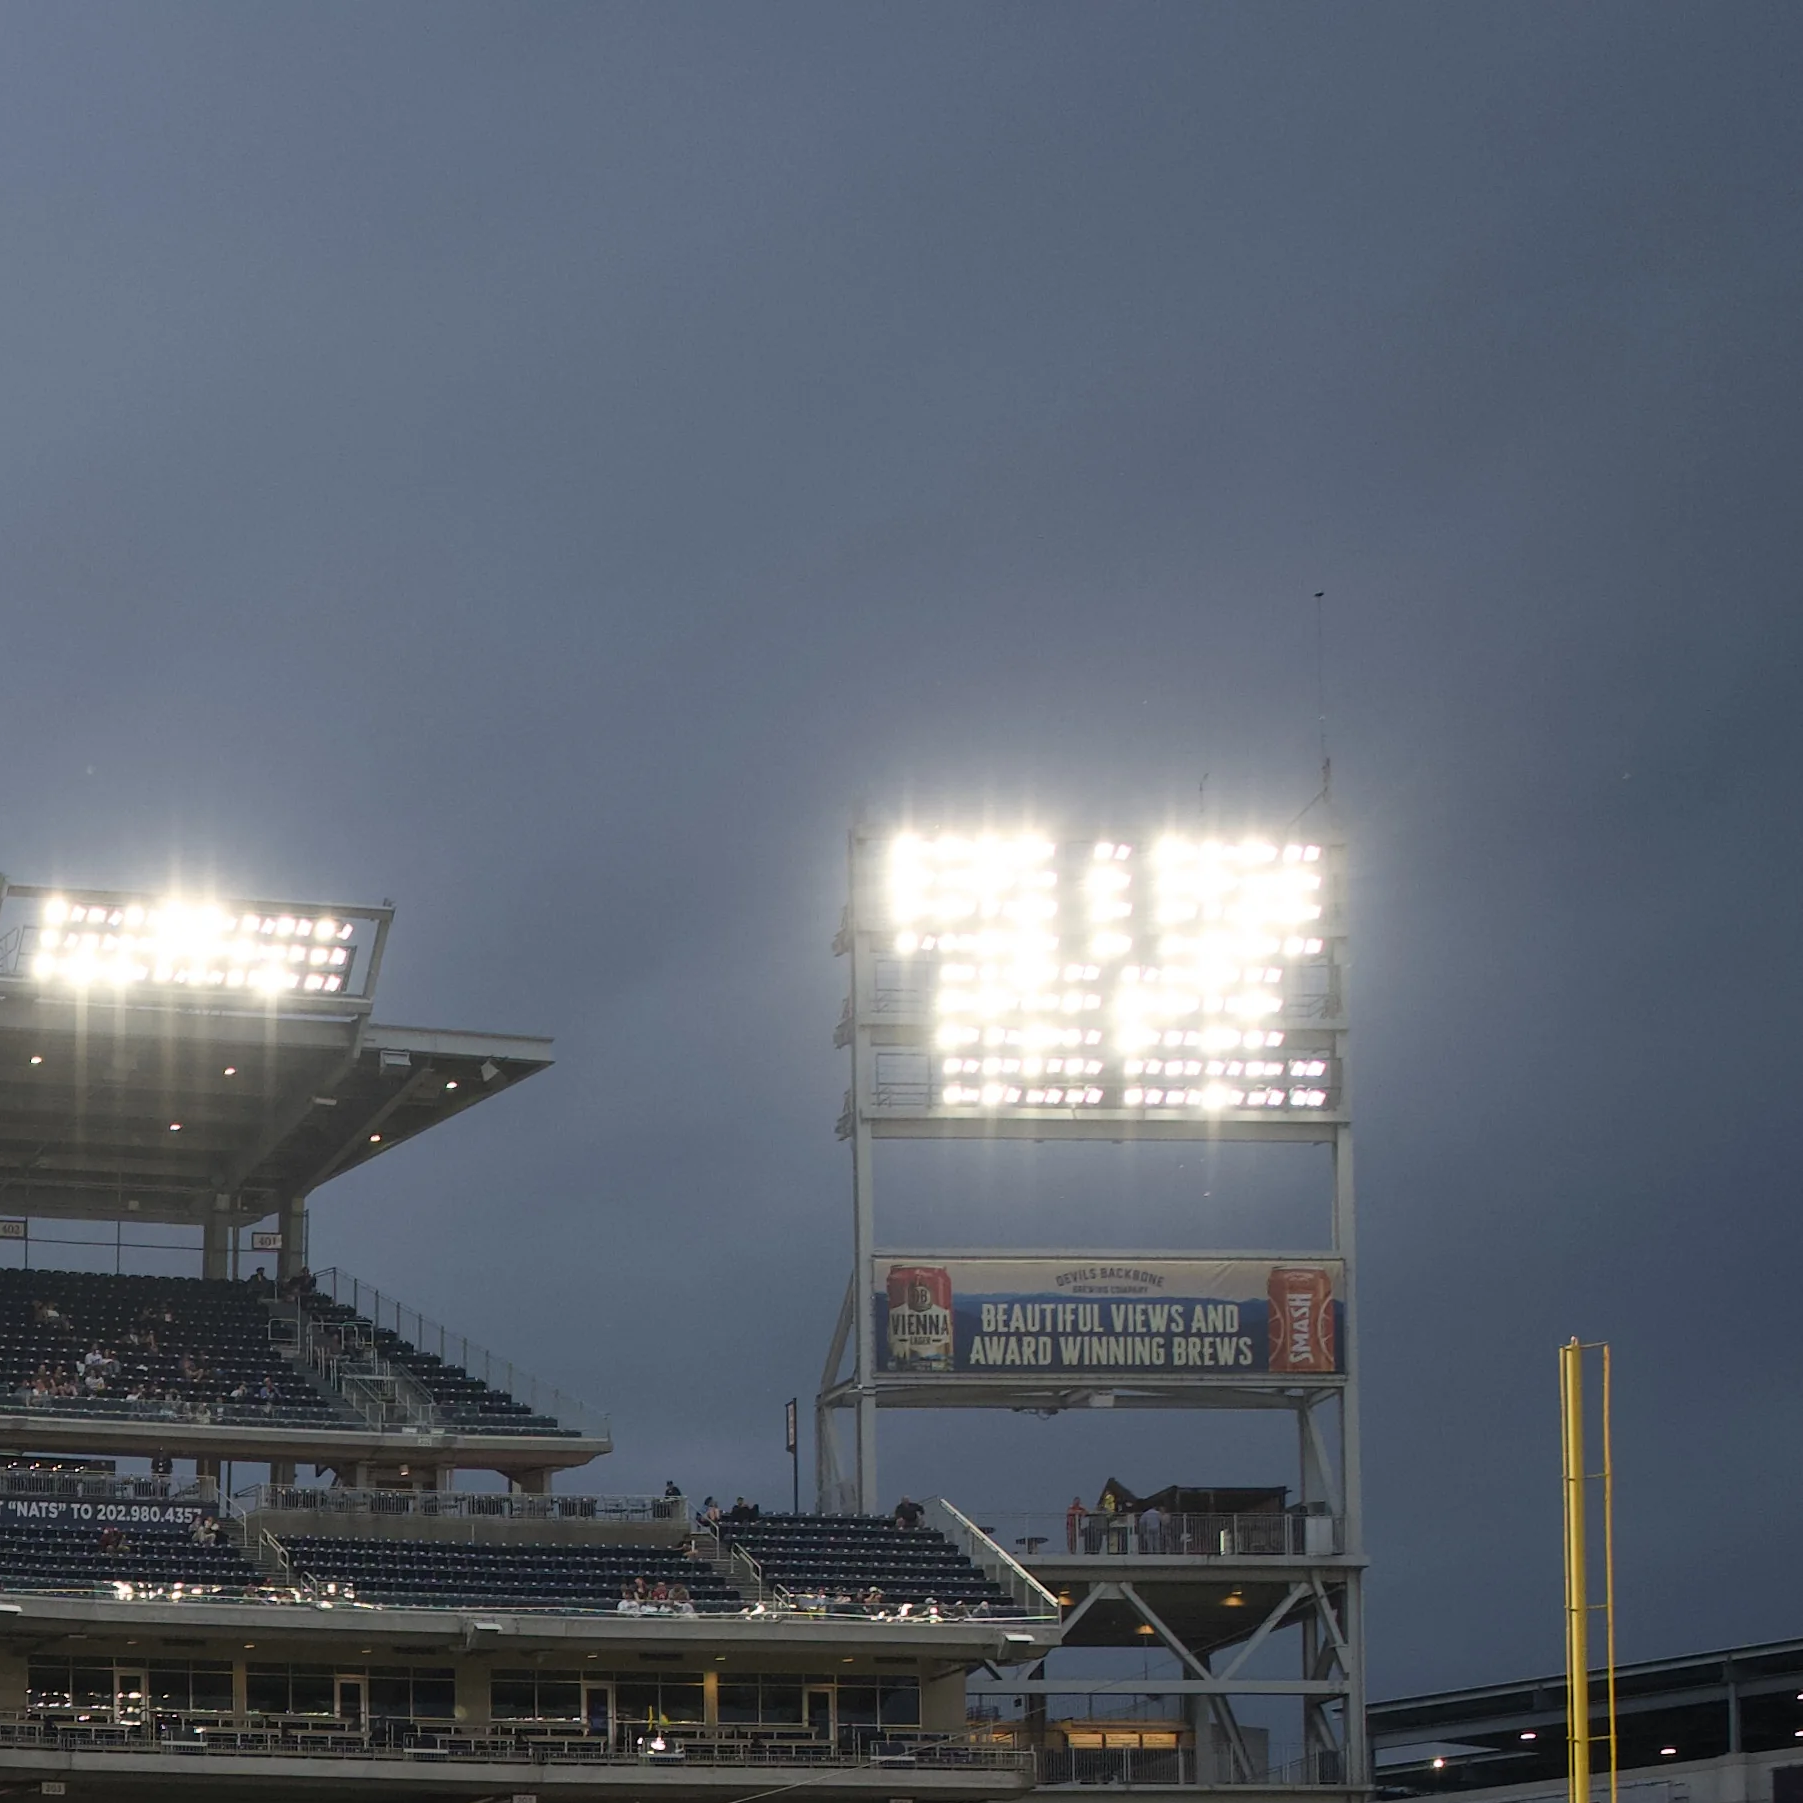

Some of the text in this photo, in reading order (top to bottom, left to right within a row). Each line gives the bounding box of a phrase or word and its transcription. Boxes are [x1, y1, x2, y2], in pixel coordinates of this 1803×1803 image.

[2, 1224, 21, 1235] 402
[1055, 1267, 1165, 1288] DEVILS BACKBONE
[892, 1313, 950, 1337] VIENNA
[981, 1303, 1240, 1333] BEAUTIFUL VIEWS AND
[1287, 1293, 1314, 1364] SMASH
[970, 1336, 1253, 1366] AWARD WINNING BREWS
[70, 1503, 92, 1519] TO
